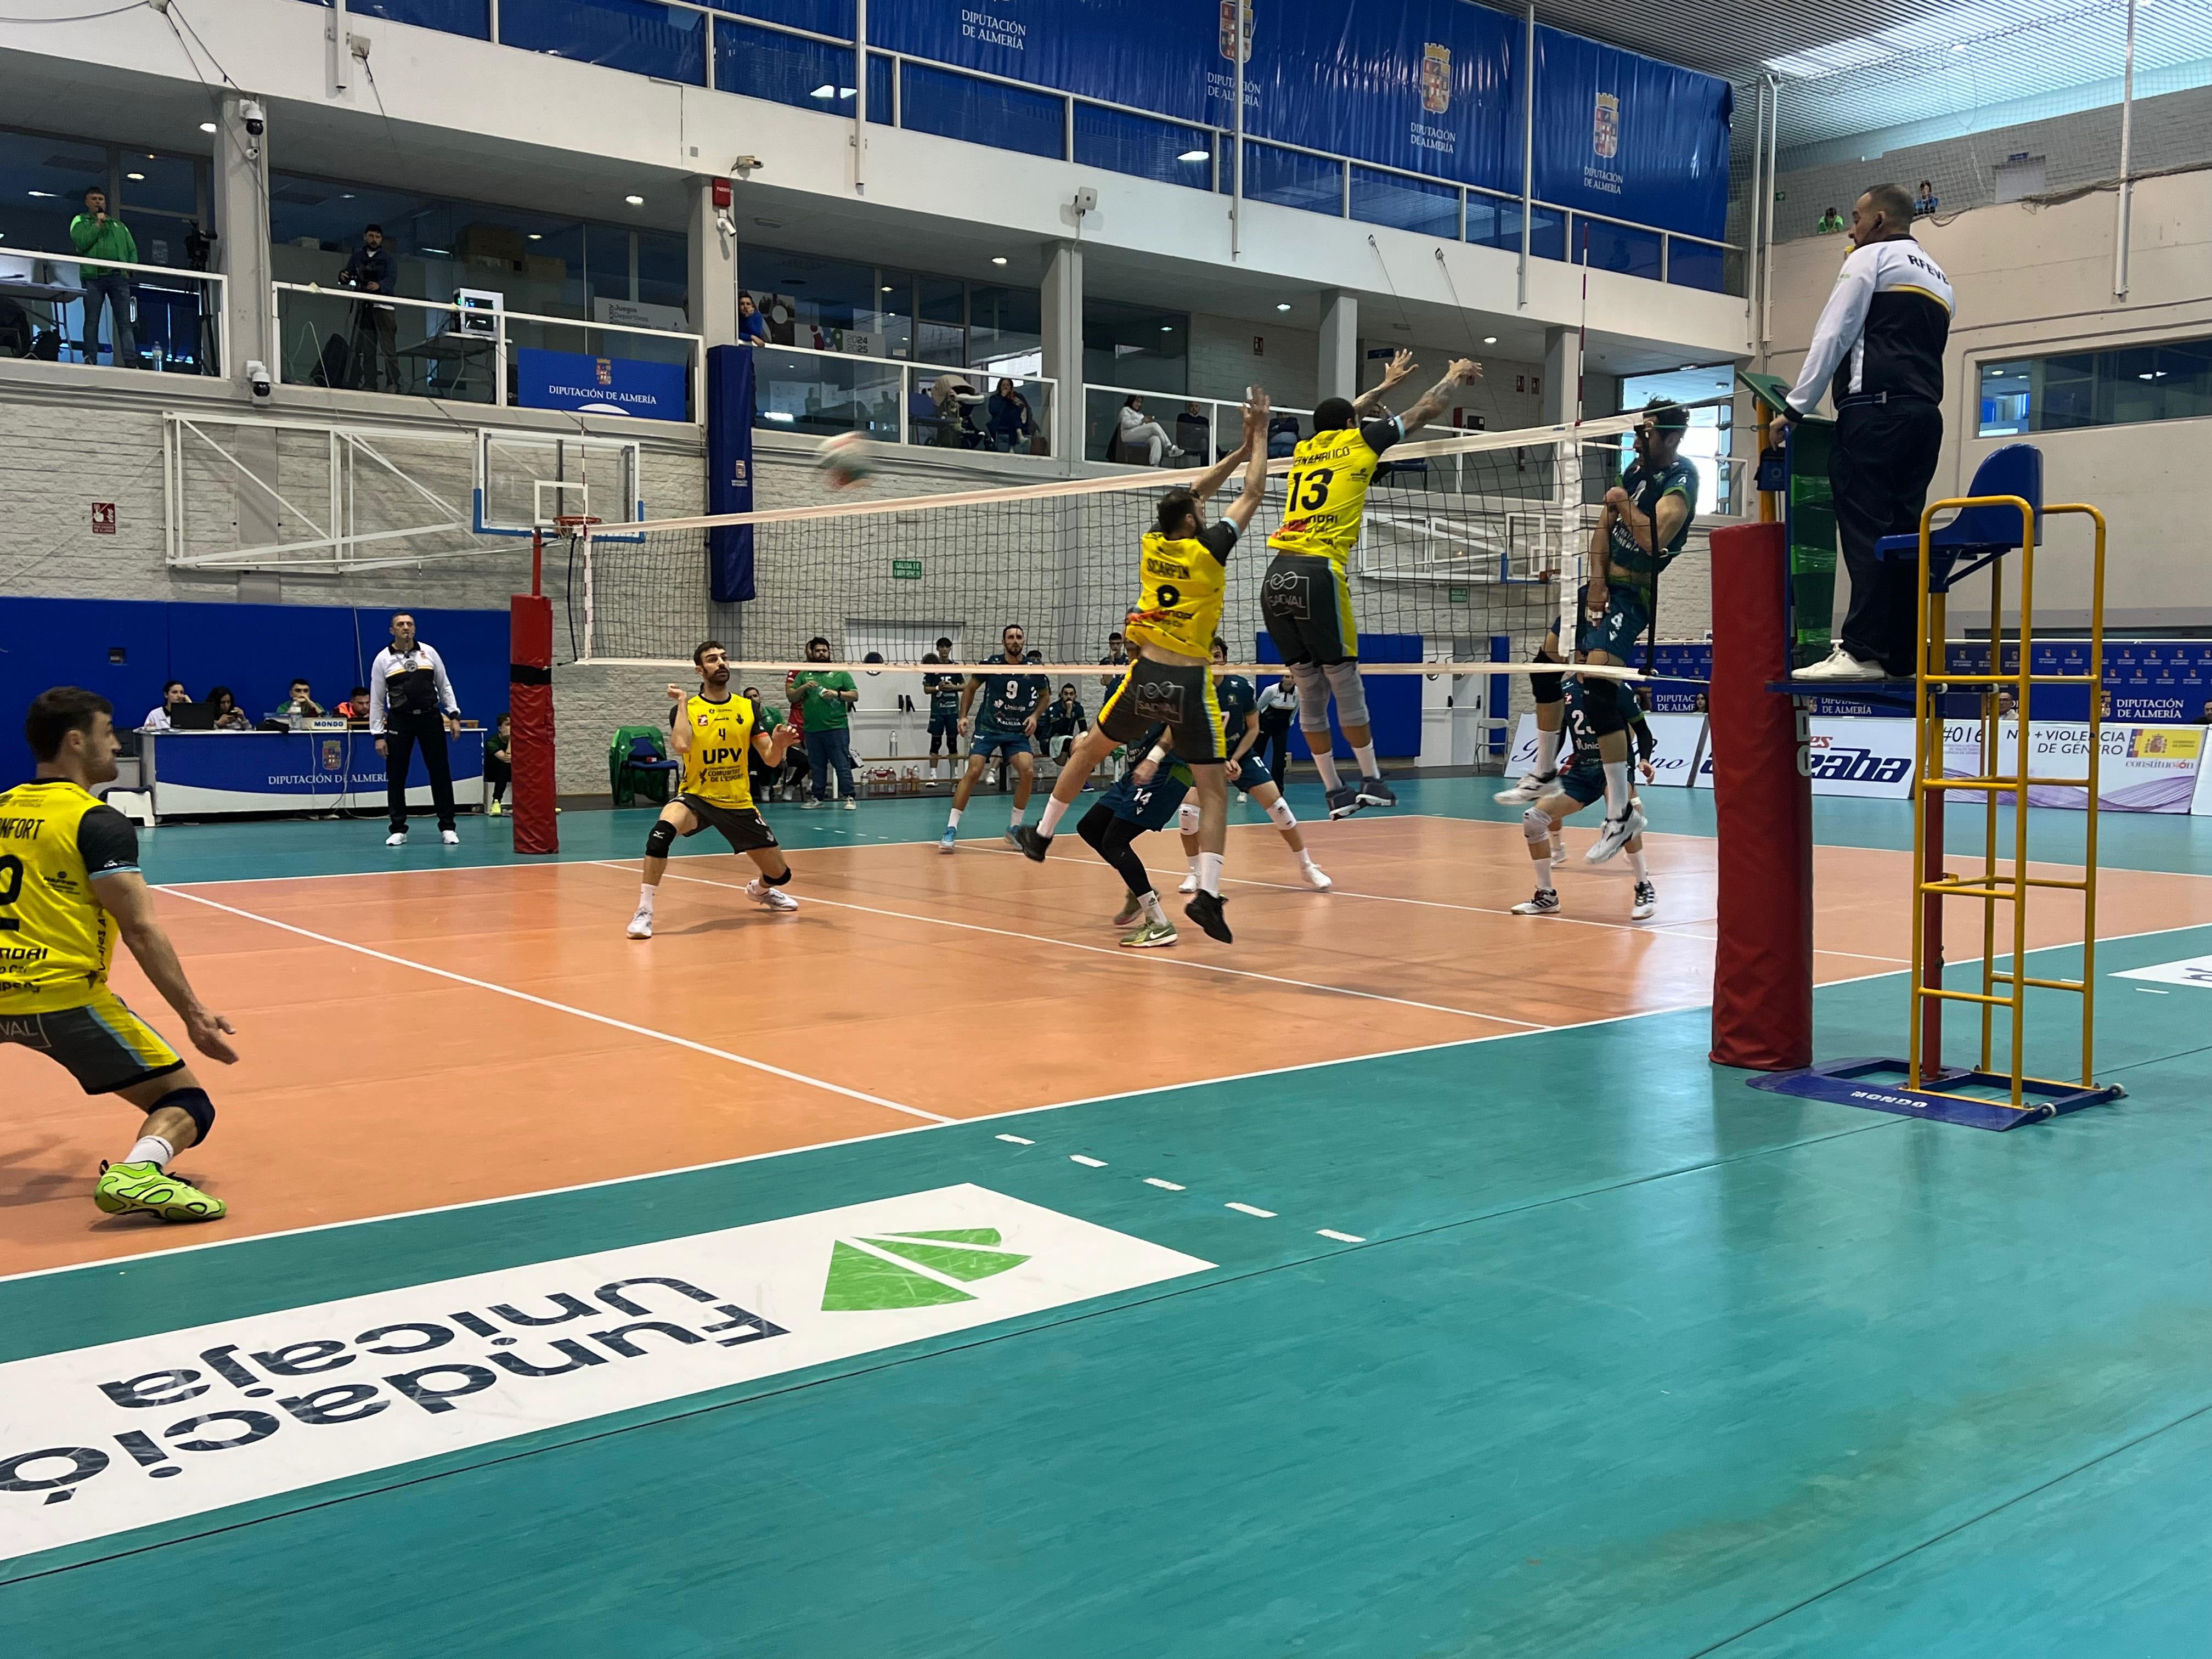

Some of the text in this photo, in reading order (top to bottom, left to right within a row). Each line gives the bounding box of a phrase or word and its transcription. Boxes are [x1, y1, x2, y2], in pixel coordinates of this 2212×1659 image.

[962, 9, 1026, 36] DIPUTACIÓN
[962, 24, 1024, 50] DE ALMERÍA
[1207, 72, 1261, 94] DIPUTIÓN
[1208, 86, 1259, 107] DE ALRÍA
[1410, 122, 1456, 142] DIPUTACIÓN
[1410, 134, 1454, 154] DE ALMERÍA
[1584, 166, 1623, 184] DIPUTACIÓN
[1584, 177, 1621, 194] DE ALMERÍA
[614, 304, 637, 314] Juegos
[847, 335, 868, 344] 2024
[847, 344, 868, 353] 2025
[549, 385, 657, 404] DIPUTACIÓN DE ALMERÍA
[1289, 468, 1334, 512] 13
[1006, 680, 1018, 699] 9
[1656, 694, 1696, 703] DIPUTAC
[2117, 698, 2184, 708] DIPUTACIÓN
[1671, 703, 1696, 712] ALME
[1835, 705, 1872, 714] ALMERÍA
[2117, 708, 2182, 718] DE ALMERÍA
[1572, 709, 1596, 735] 2
[718, 728, 726, 741] 4
[2007, 730, 2029, 740] N
[2046, 730, 2125, 742] VIOLECIA
[703, 748, 742, 764] UPV
[2038, 741, 2123, 755] DE GÉNRO
[268, 772, 331, 784] DIPUTACIÓN
[350, 771, 388, 782] ALMERÍ
[1133, 788, 1152, 805] 14
[0, 818, 45, 840] NFORT
[1851, 1091, 1928, 1108] MONDO
[97, 1277, 719, 1408] Unicaja
